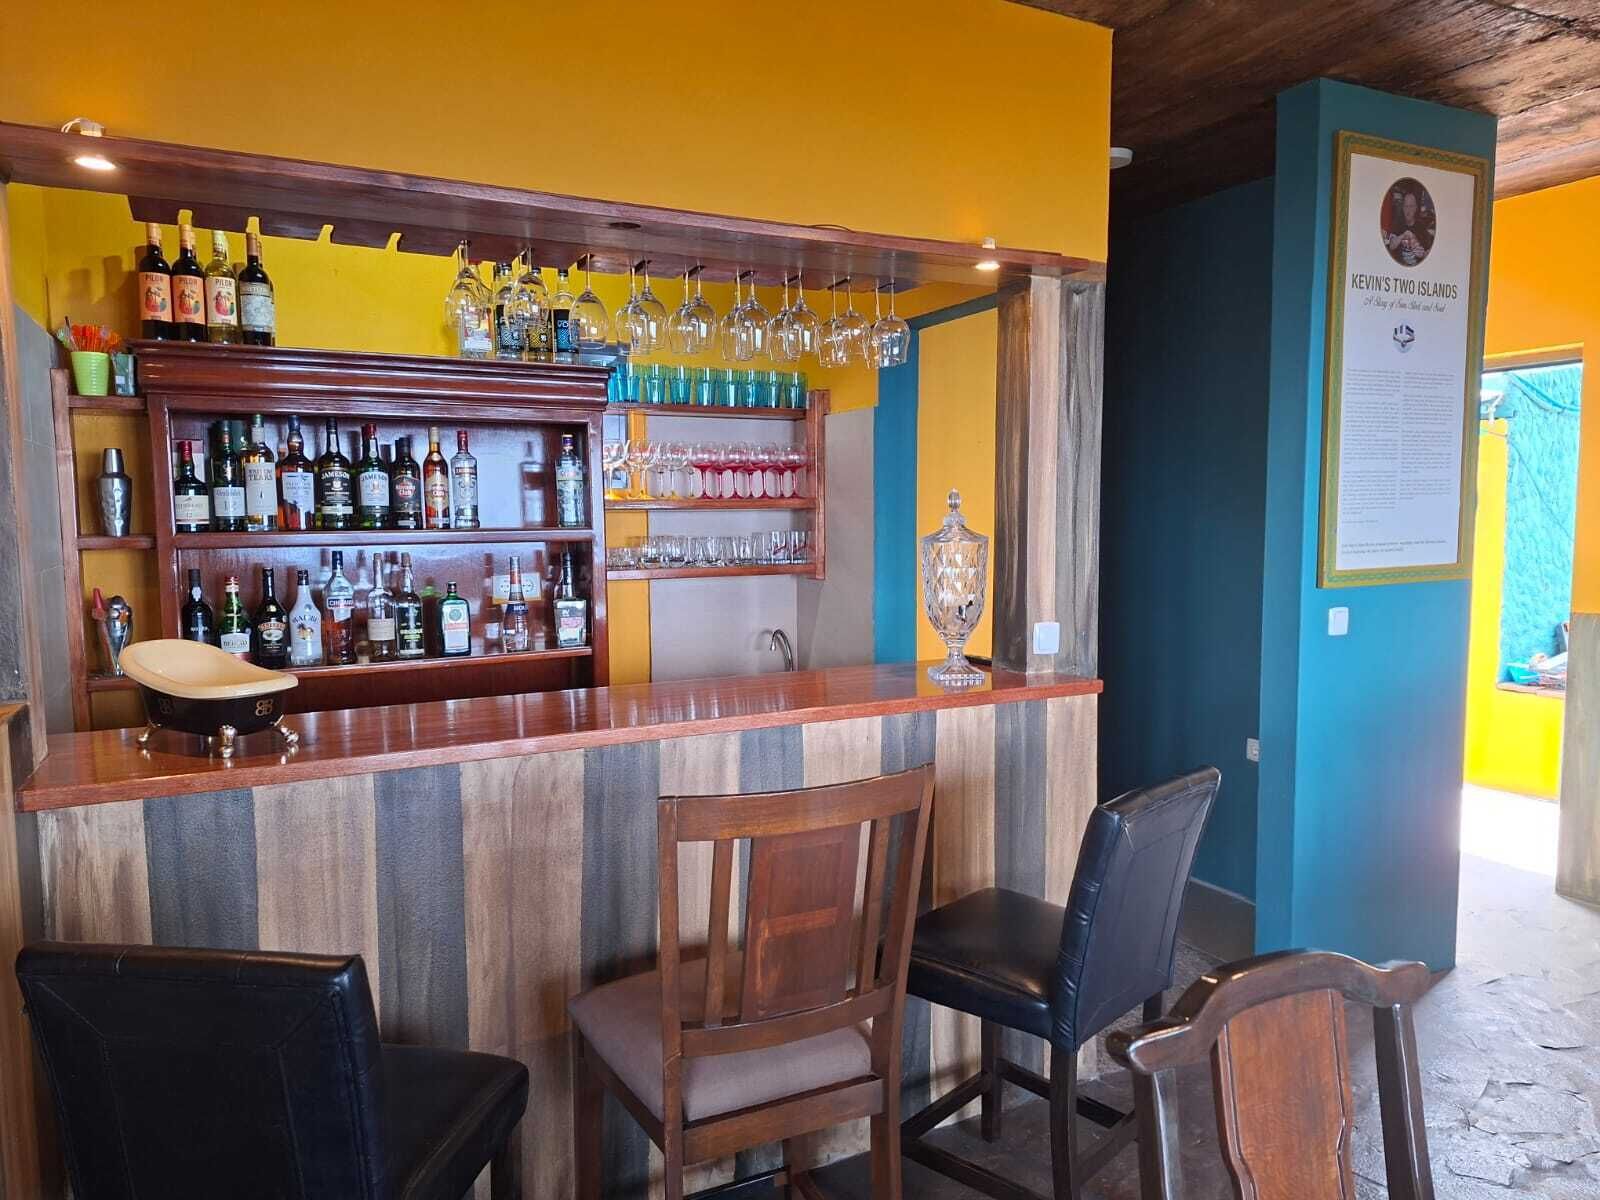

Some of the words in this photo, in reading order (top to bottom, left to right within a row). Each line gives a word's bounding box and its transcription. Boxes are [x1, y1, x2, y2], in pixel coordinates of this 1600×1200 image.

[1351, 272, 1391, 292] KEVIN'S
[1393, 278, 1415, 295] TWO
[1417, 281, 1458, 300] ISLANDS
[320, 470, 350, 480] JAMESON
[360, 472, 388, 482] JAMESON
